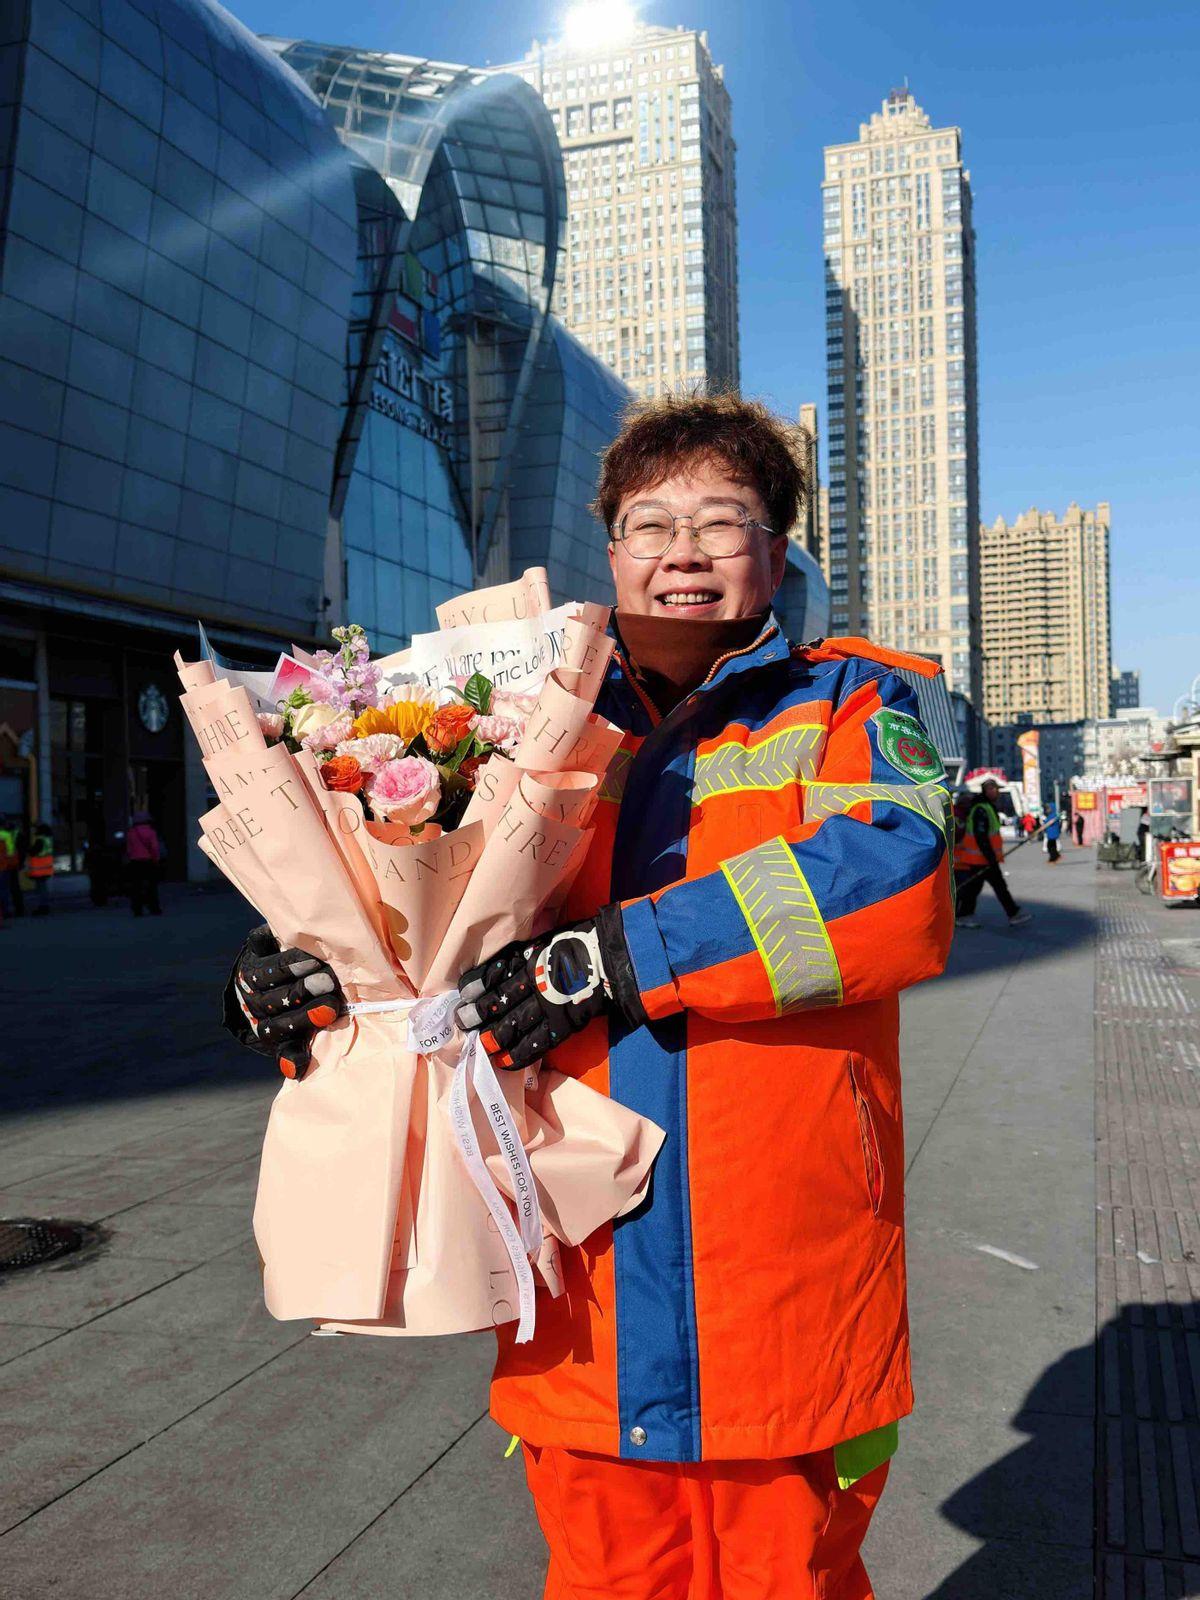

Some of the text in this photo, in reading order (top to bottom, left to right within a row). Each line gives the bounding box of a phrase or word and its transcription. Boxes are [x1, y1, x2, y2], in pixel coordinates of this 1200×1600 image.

[490, 1102, 532, 1218] BEST WISHES FOR YOU
